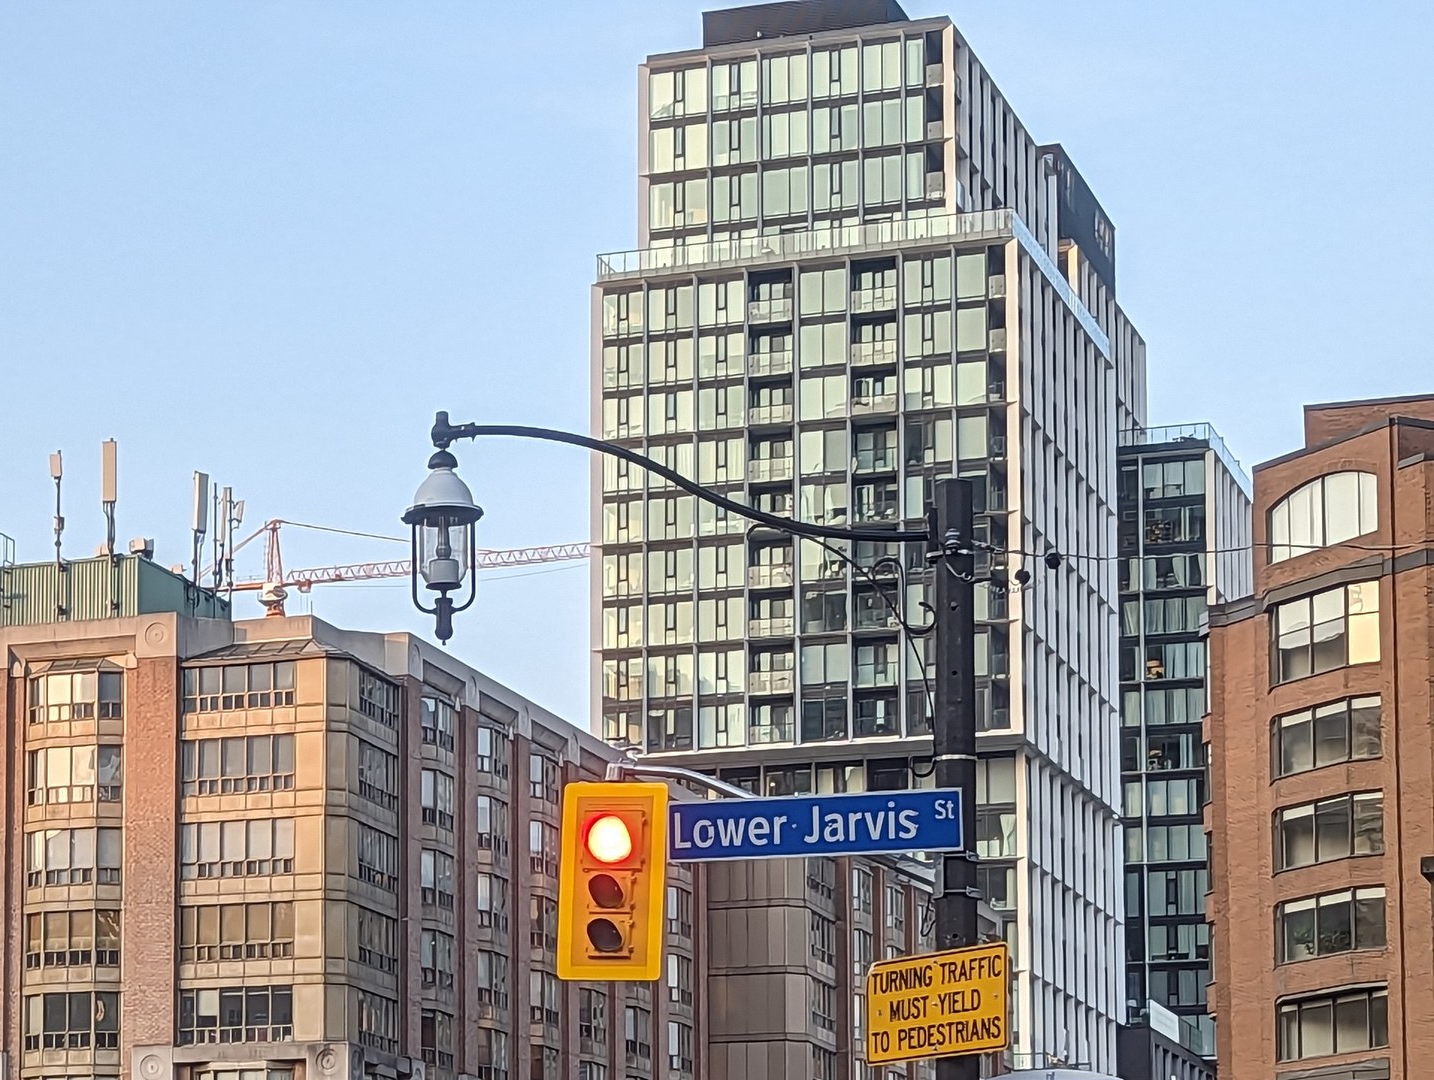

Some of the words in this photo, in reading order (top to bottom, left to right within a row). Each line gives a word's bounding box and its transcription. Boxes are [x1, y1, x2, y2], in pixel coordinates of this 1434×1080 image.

[674, 812, 788, 849] Lower
[803, 801, 919, 844] Jarvis
[934, 800, 955, 820] St
[871, 965, 933, 995] TURNING
[939, 954, 1002, 985] TRAFFIC
[889, 995, 929, 1022] MUST
[937, 989, 981, 1016] YIELD
[871, 1031, 890, 1054] TO
[898, 1016, 1001, 1051] PEDESTRIANS
